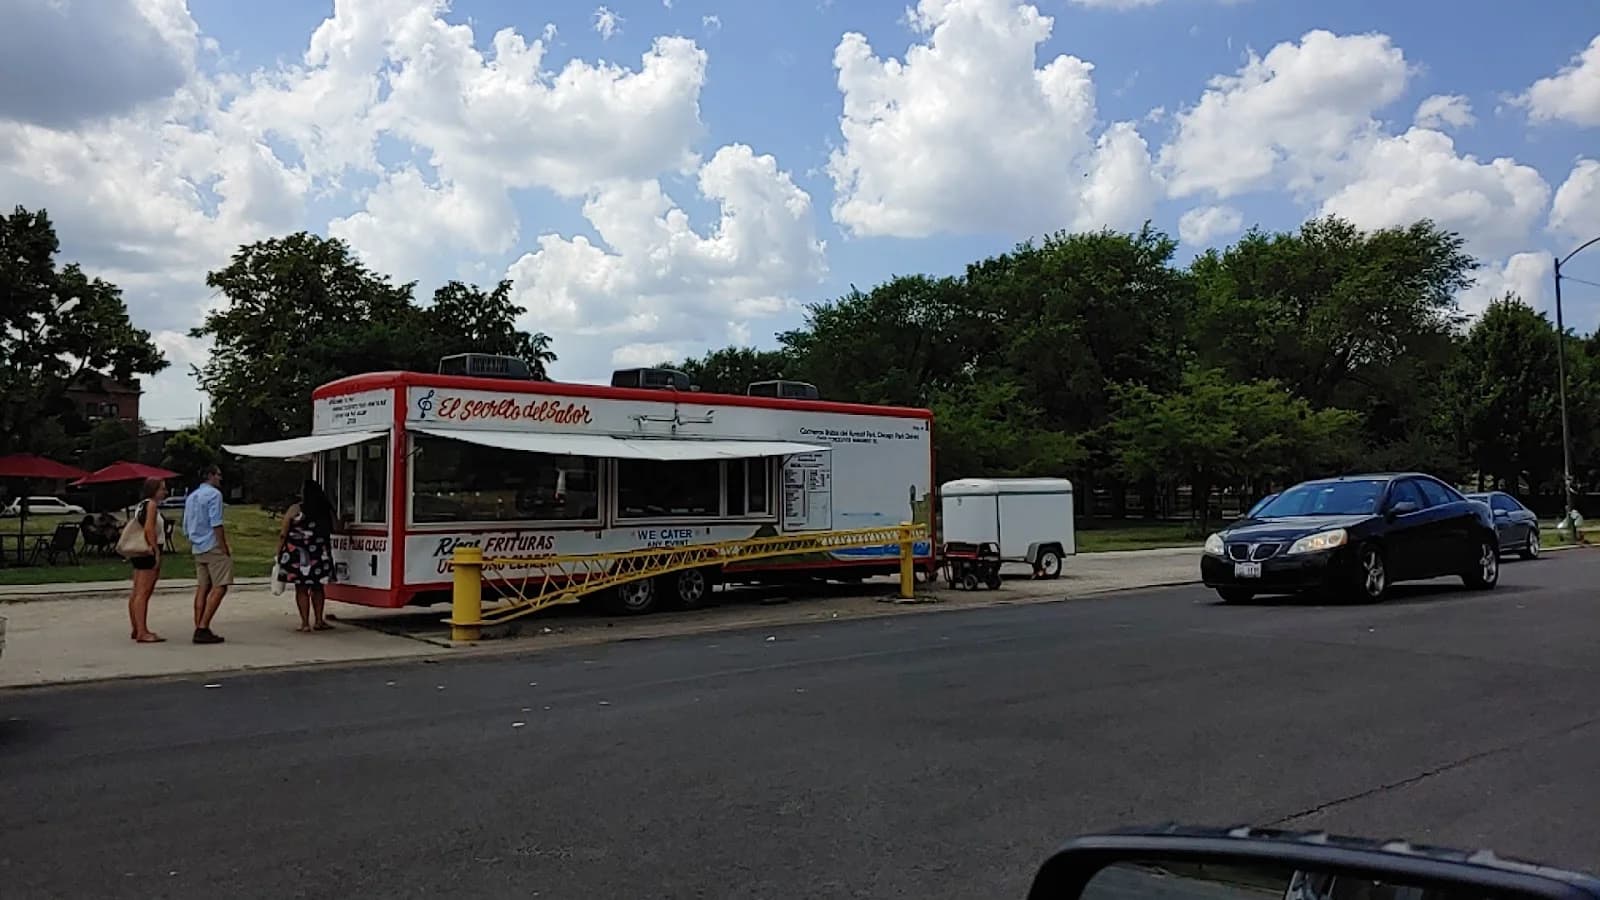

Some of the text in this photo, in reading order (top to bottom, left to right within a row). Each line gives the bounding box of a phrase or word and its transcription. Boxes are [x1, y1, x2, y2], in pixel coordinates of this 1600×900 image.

[438, 397, 458, 418] El
[522, 400, 549, 422] del
[548, 400, 593, 424] Sabor
[638, 529, 692, 540] WE CATER
[484, 535, 555, 552] FRITURAS
